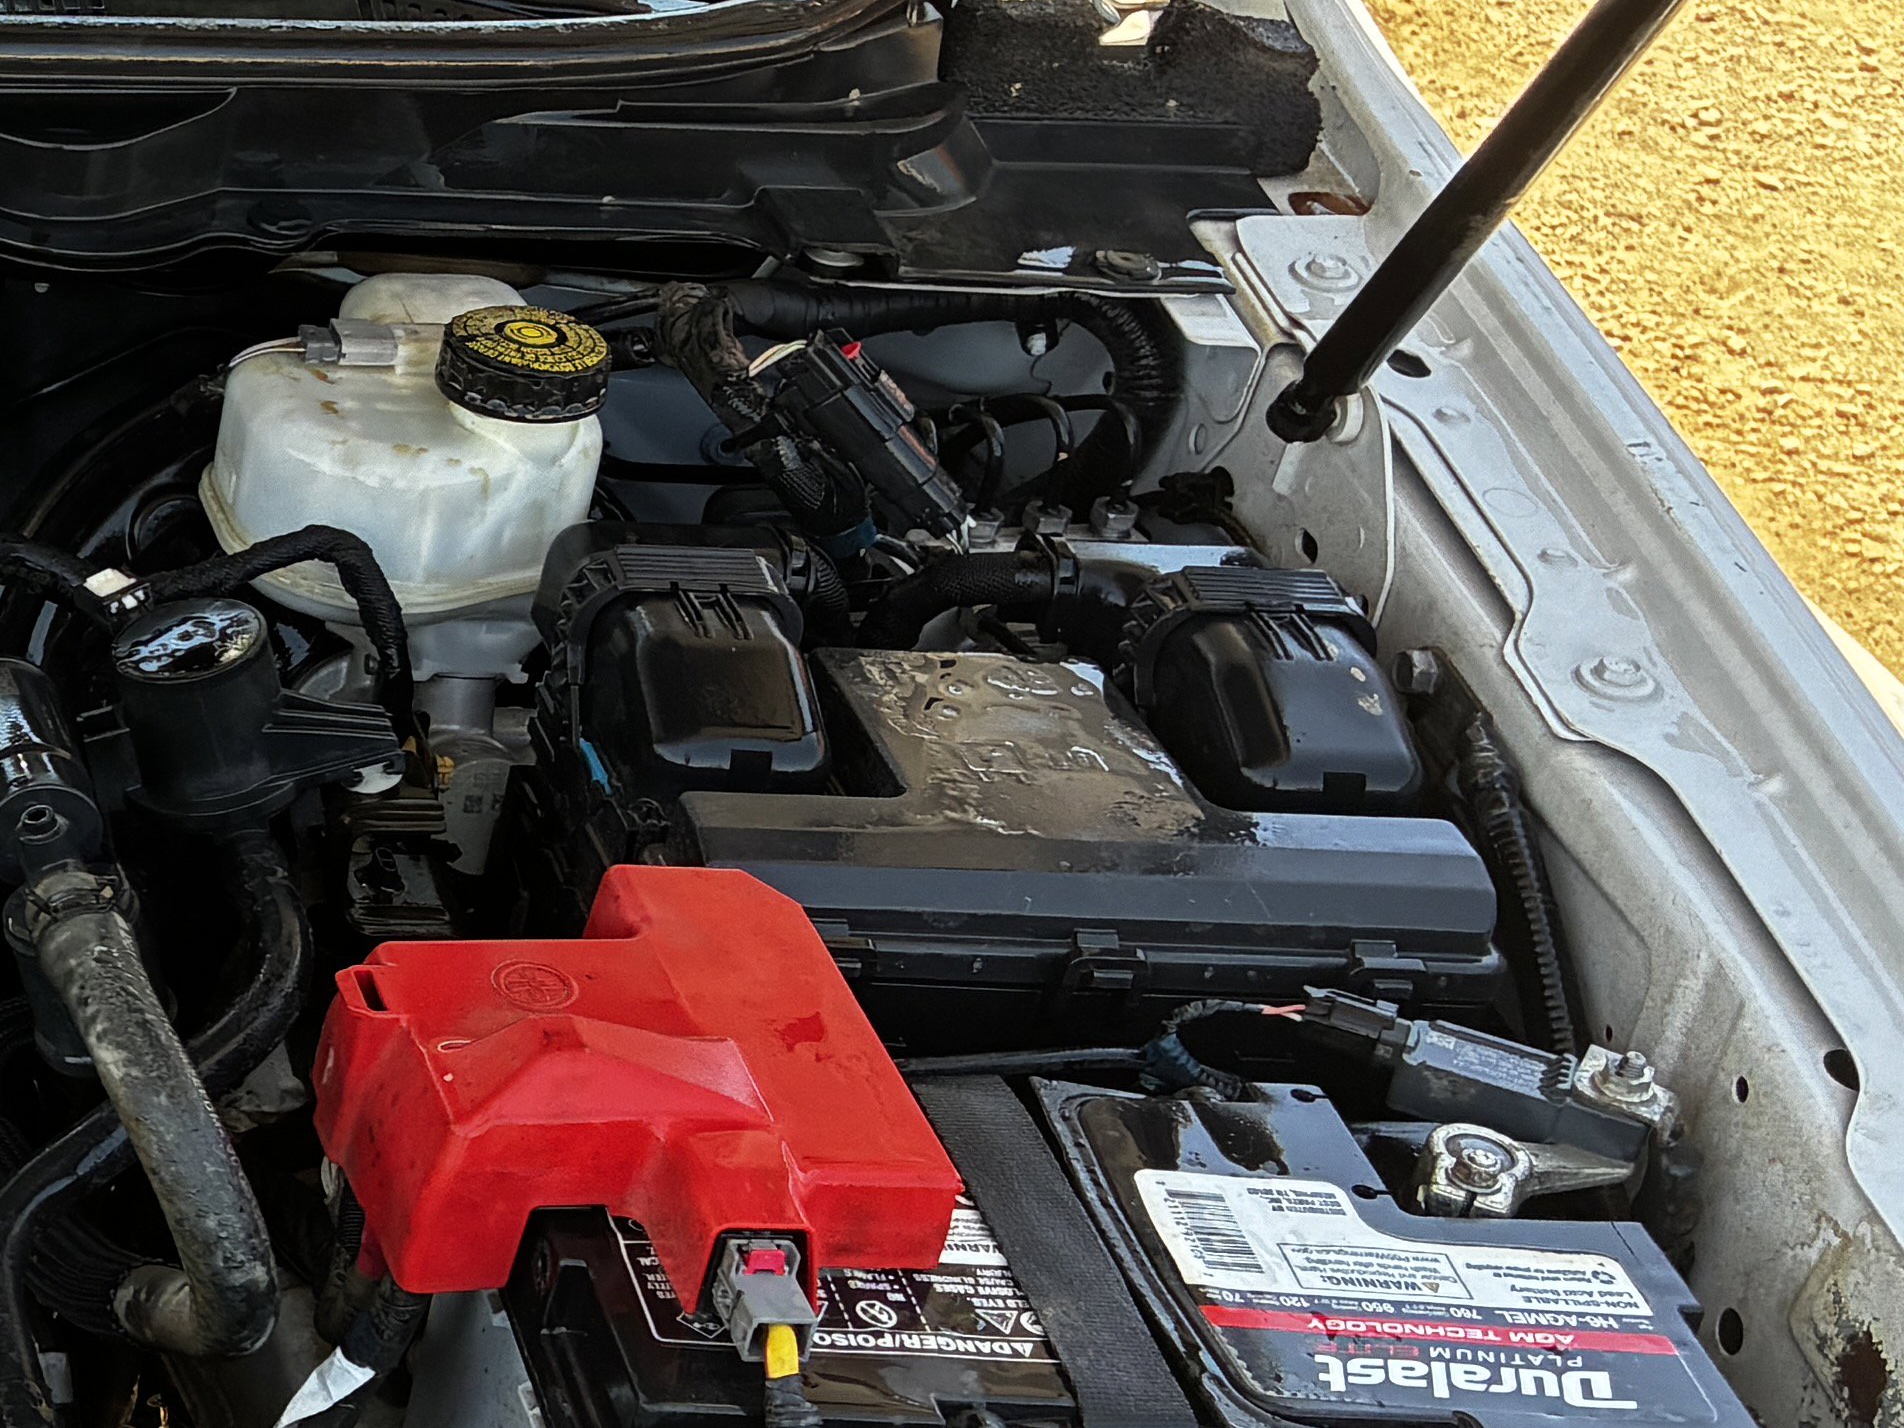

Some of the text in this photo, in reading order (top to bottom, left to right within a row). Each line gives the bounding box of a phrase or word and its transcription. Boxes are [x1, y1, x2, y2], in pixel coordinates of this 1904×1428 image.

[1320, 1275, 1423, 1292] WARNING:
[1222, 1291, 1245, 1303] 70
[1279, 1296, 1310, 1308] 120
[1494, 1310, 1619, 1328] H6-AGMEL
[1306, 1316, 1574, 1344] AGM TECHNOLOGY
[812, 1332, 1012, 1354] DANGER/POISO
[1428, 1346, 1583, 1368] PLATINUM
[1314, 1353, 1638, 1410] Duralast
